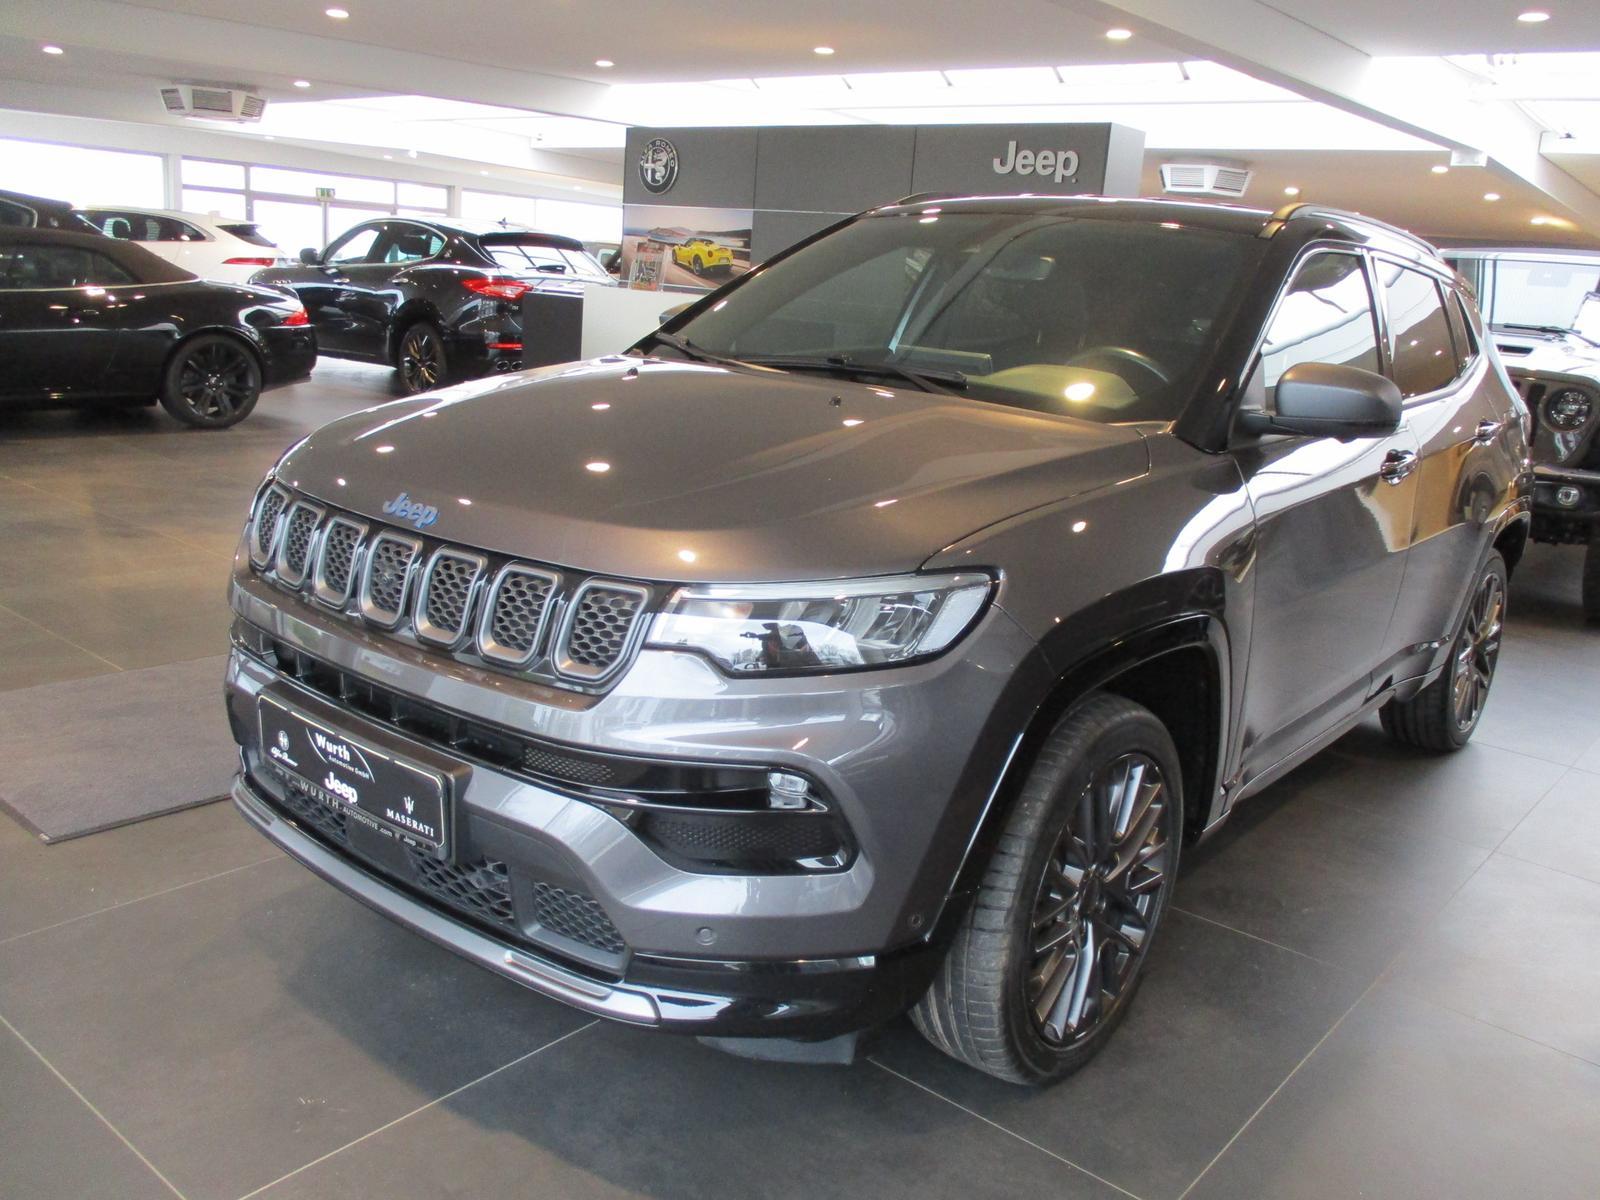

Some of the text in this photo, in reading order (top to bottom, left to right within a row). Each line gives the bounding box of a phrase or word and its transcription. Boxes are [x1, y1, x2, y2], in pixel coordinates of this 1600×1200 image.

[655, 140, 675, 168] ROMEO
[992, 140, 1079, 183] Jeep
[382, 492, 439, 529] Jeep
[315, 732, 350, 762] Wurth
[325, 771, 357, 804] Jeep
[386, 807, 434, 838] MASERATI
